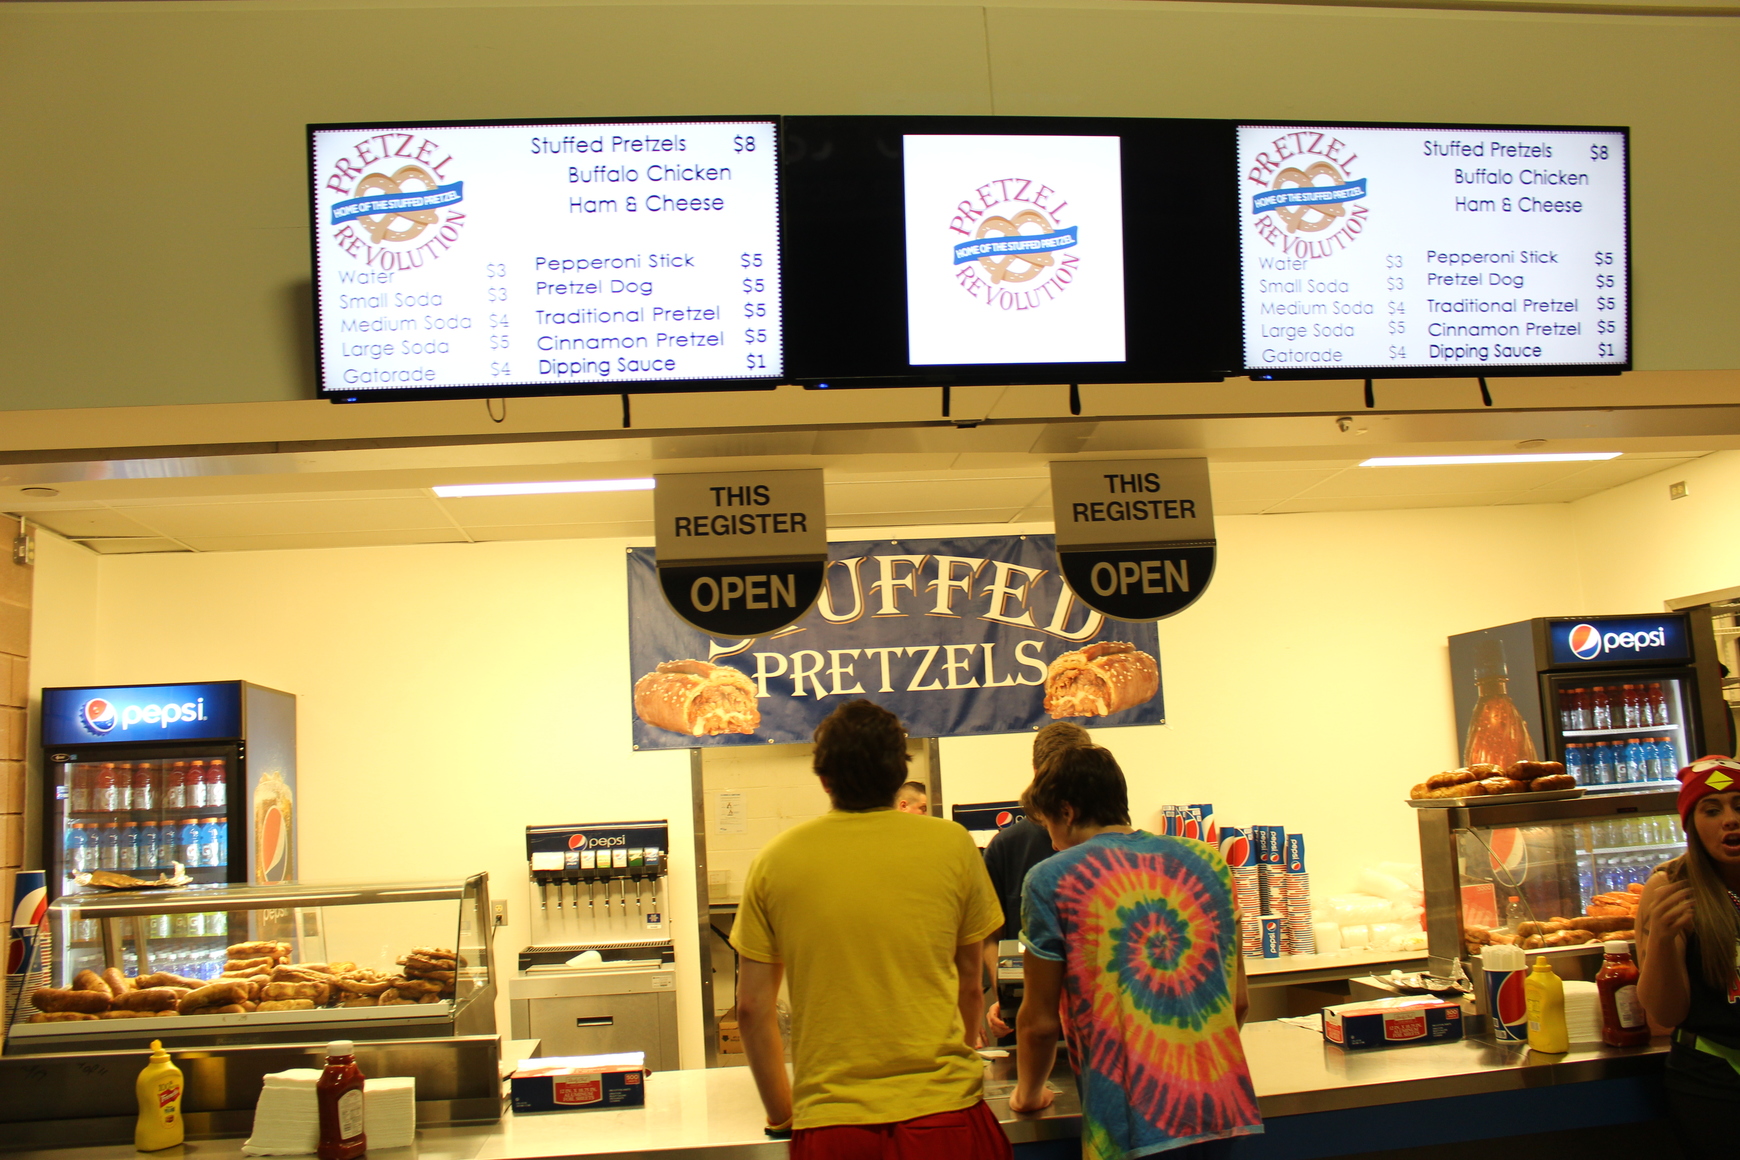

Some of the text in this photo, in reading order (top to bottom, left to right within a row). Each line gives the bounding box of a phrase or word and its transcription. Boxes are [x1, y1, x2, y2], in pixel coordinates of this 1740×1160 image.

[531, 135, 755, 154] Stuffed Pretzels $8
[1423, 140, 1609, 162] Stuffed Pretzels $8
[325, 132, 453, 196] PRETZEL
[1247, 131, 1358, 187] PRETZEL
[568, 164, 732, 183] Buffalo Chicken
[1455, 168, 1589, 186] Buffalo Chicken
[569, 194, 725, 213] Ham & Cheese
[949, 178, 1068, 236] PRETZEL
[1455, 196, 1583, 213] Ham & Cheese
[333, 209, 467, 271] REVOLUTION
[1254, 203, 1369, 259] REVOLUTION
[536, 252, 763, 272] Pepperoni Stick $5
[1259, 254, 1403, 270] Water $3
[1427, 250, 1614, 266] Pepperoni Stick $5
[338, 262, 507, 285] Water $3
[955, 252, 1080, 311] REVOLUTION
[1259, 276, 1404, 293] Small Soda $3
[1427, 272, 1615, 289] Pretzel Dog $5
[339, 286, 508, 309] Small Soda $3
[536, 278, 765, 296] Pretzel Dog $5
[536, 302, 766, 325] Traditional Pretzel $5
[1260, 300, 1406, 315] Medium Soda $4
[1427, 296, 1616, 313] Traditional Pretzel $5
[340, 312, 509, 332] Medium Soda $4
[1261, 320, 1406, 341] Large Soda $5
[1428, 319, 1616, 337] Cinnamon Pretzel $5
[342, 333, 510, 359] Large Soda $5
[537, 328, 767, 350] Cinnamon Pretzel $5
[1262, 344, 1407, 363] Gatorade $4
[1429, 342, 1615, 361] Dipping Sauce $1
[343, 360, 511, 383] Gatorade $4
[539, 353, 767, 377] Dipping Sauce $1
[1103, 472, 1161, 494] THIS
[709, 484, 771, 507] THIS
[1072, 499, 1197, 522] REGISTER
[674, 512, 807, 537] REGISTER
[1090, 559, 1190, 597] OPEN
[690, 573, 797, 613] OPEN
[1603, 626, 1666, 653] pepsi
[751, 640, 1048, 700] PRETZELS
[122, 697, 205, 730] pepsi
[589, 835, 626, 848] pepsi
[1270, 830, 1279, 852] pepsi
[1291, 838, 1300, 860] pepsi
[1267, 932, 1277, 954] pepsi
